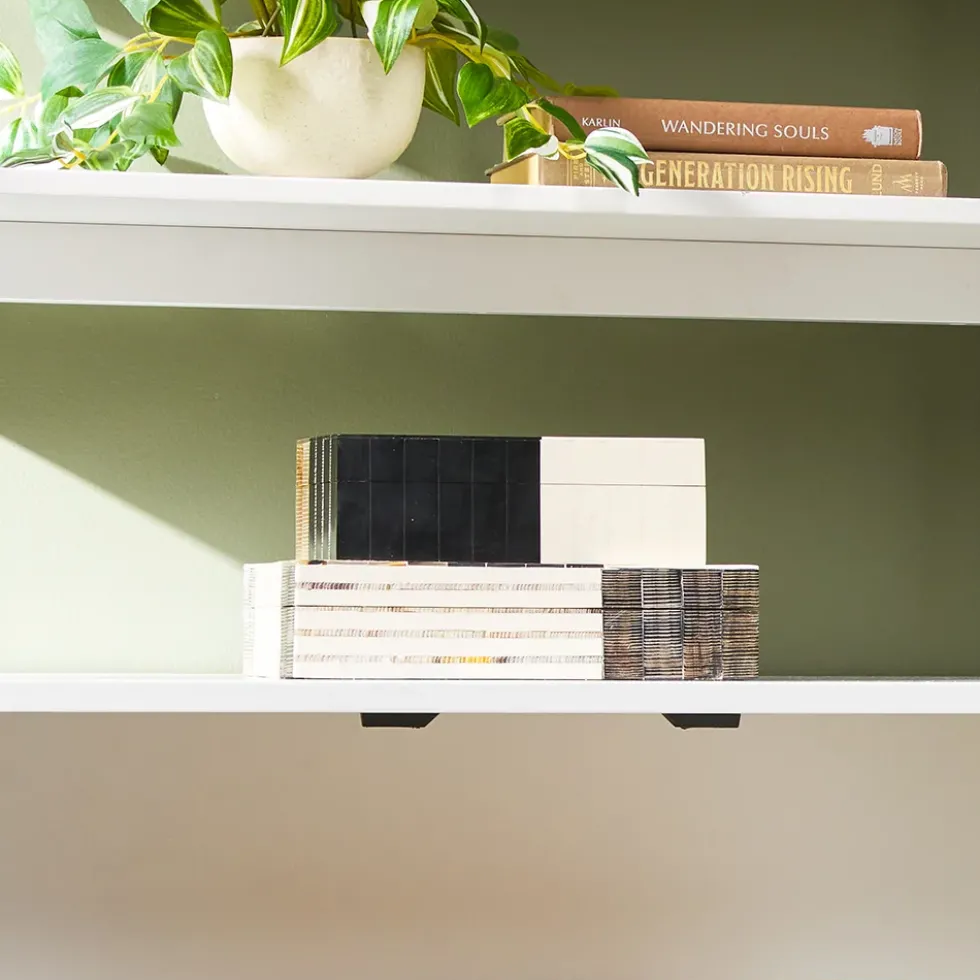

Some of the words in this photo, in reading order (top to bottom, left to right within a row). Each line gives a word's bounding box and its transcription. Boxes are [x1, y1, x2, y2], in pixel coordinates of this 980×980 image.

[581, 117, 621, 128] KARLIN
[661, 119, 768, 138] WANDERING
[773, 124, 830, 141] SOULS
[640, 159, 776, 191] GENERATION
[782, 164, 853, 194] RISING
